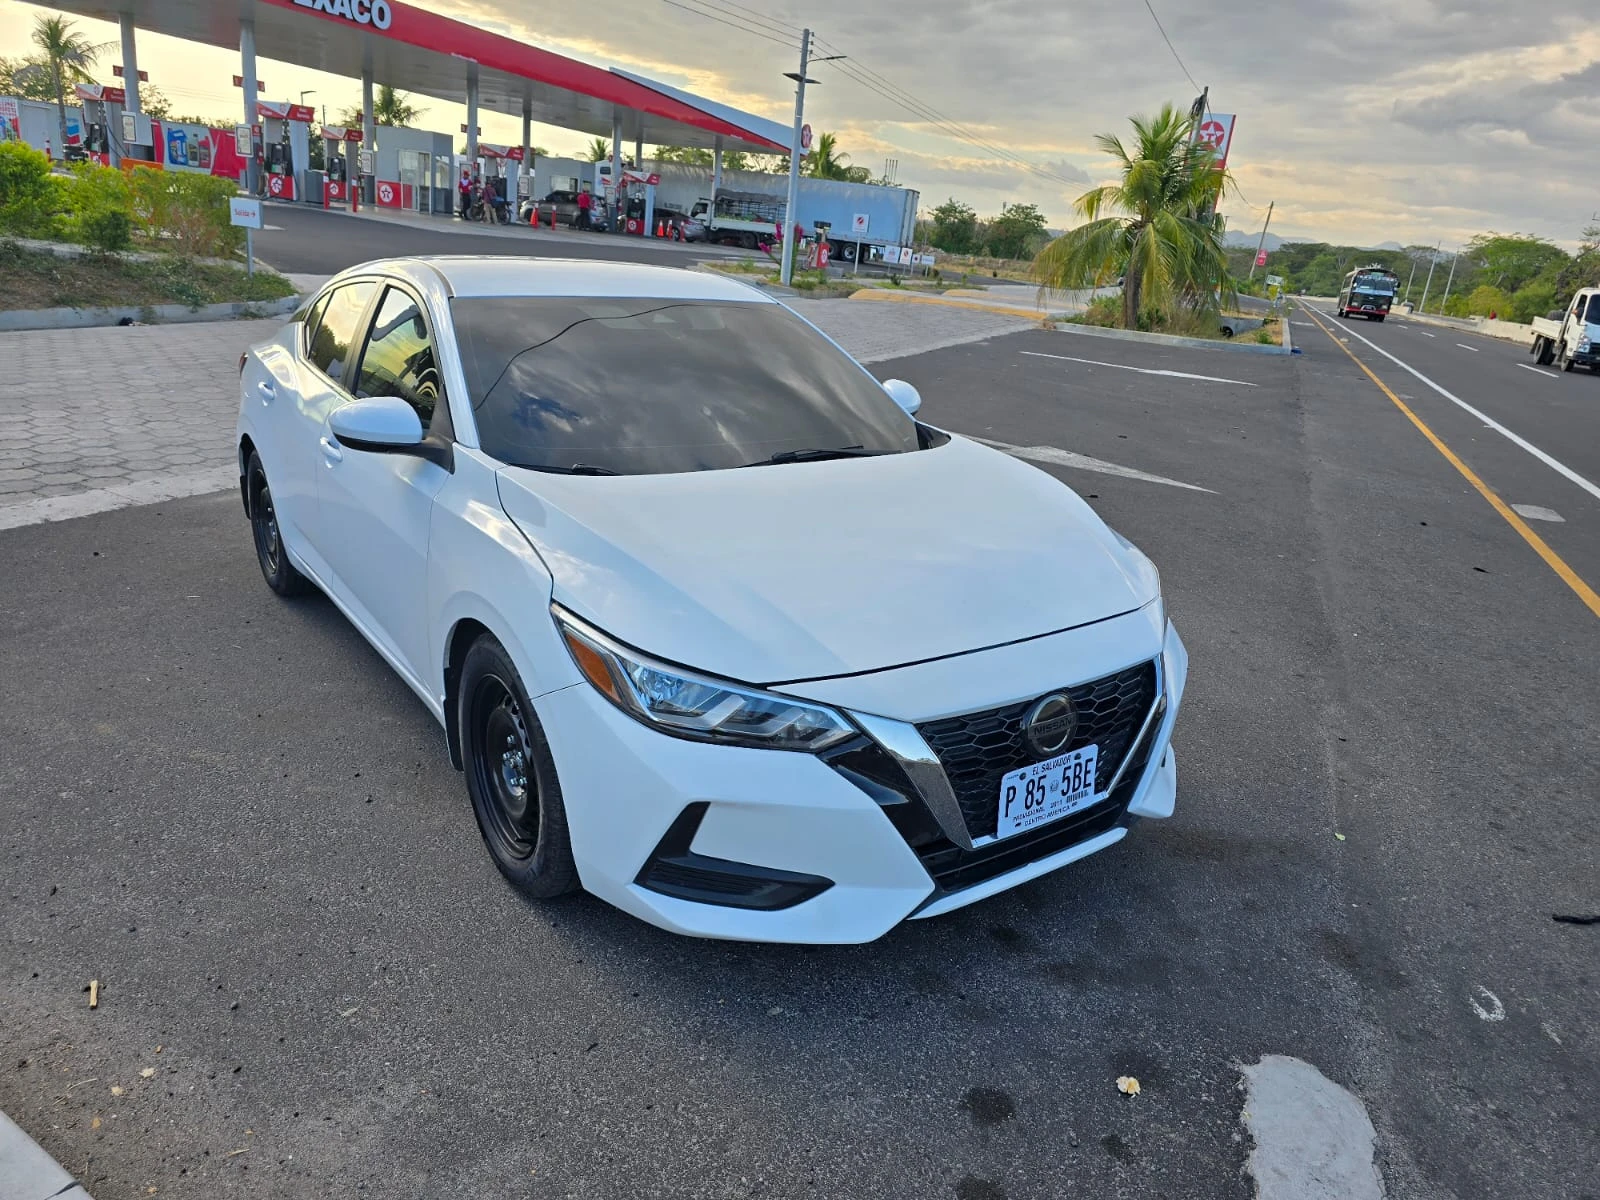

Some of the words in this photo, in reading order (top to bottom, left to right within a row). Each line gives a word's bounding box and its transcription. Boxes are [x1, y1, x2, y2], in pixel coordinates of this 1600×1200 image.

[294, 0, 391, 30] ACO
[1034, 717, 1073, 735] NISSAN
[1032, 766, 1039, 775] EL
[1041, 755, 1071, 773] SALVADOR
[1005, 785, 1016, 818] P
[1024, 774, 1047, 810] 85
[1061, 757, 1094, 796] 5BE
